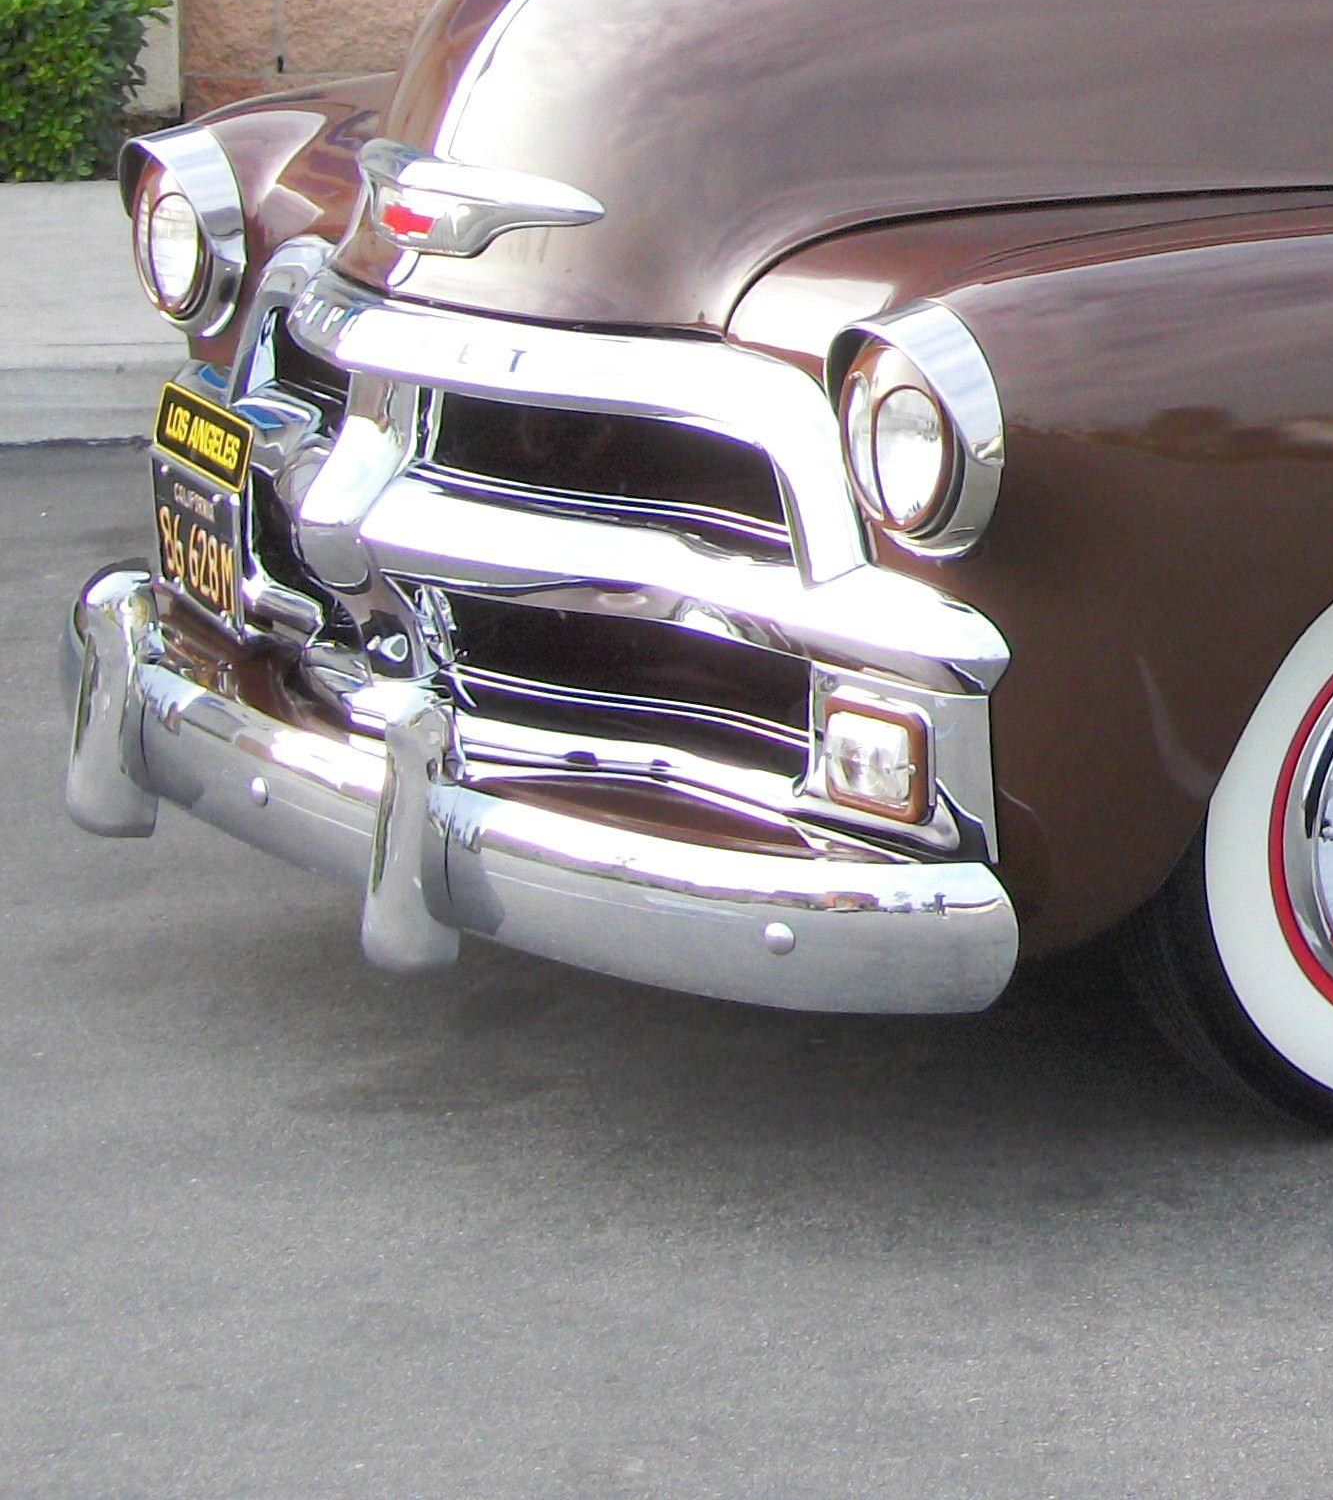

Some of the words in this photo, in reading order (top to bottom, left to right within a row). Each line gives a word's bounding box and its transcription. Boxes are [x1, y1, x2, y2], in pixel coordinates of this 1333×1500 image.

[165, 402, 190, 442] LOS
[186, 415, 241, 471] ANGELES
[188, 522, 235, 617] 628M
